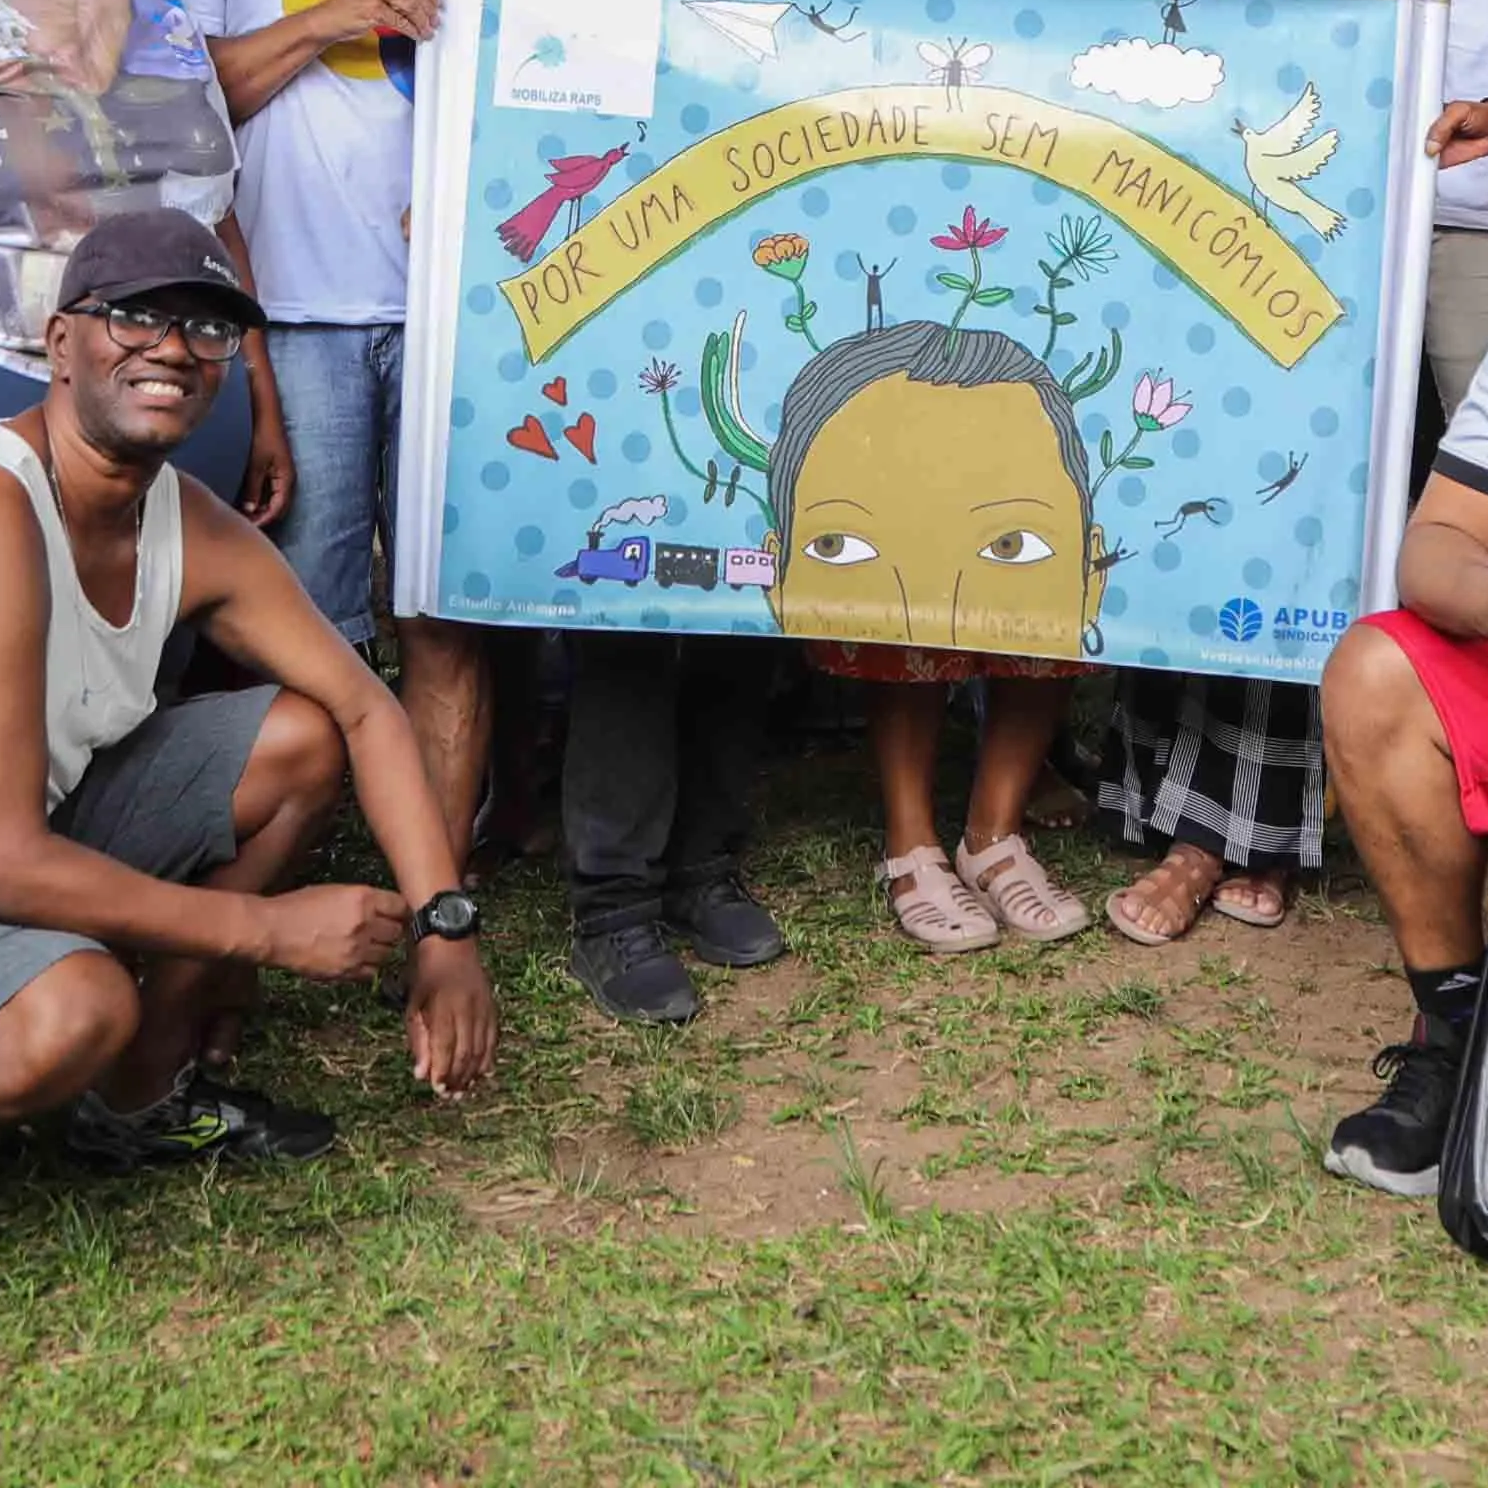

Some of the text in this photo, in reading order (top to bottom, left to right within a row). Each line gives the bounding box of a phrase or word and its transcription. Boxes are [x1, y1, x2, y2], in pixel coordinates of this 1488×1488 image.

[511, 87, 568, 104] MOBILIZA
[520, 105, 1324, 338] POR UMA SOCIEDADE SEM MANICÔMIOS
[1273, 607, 1348, 631] APUB
